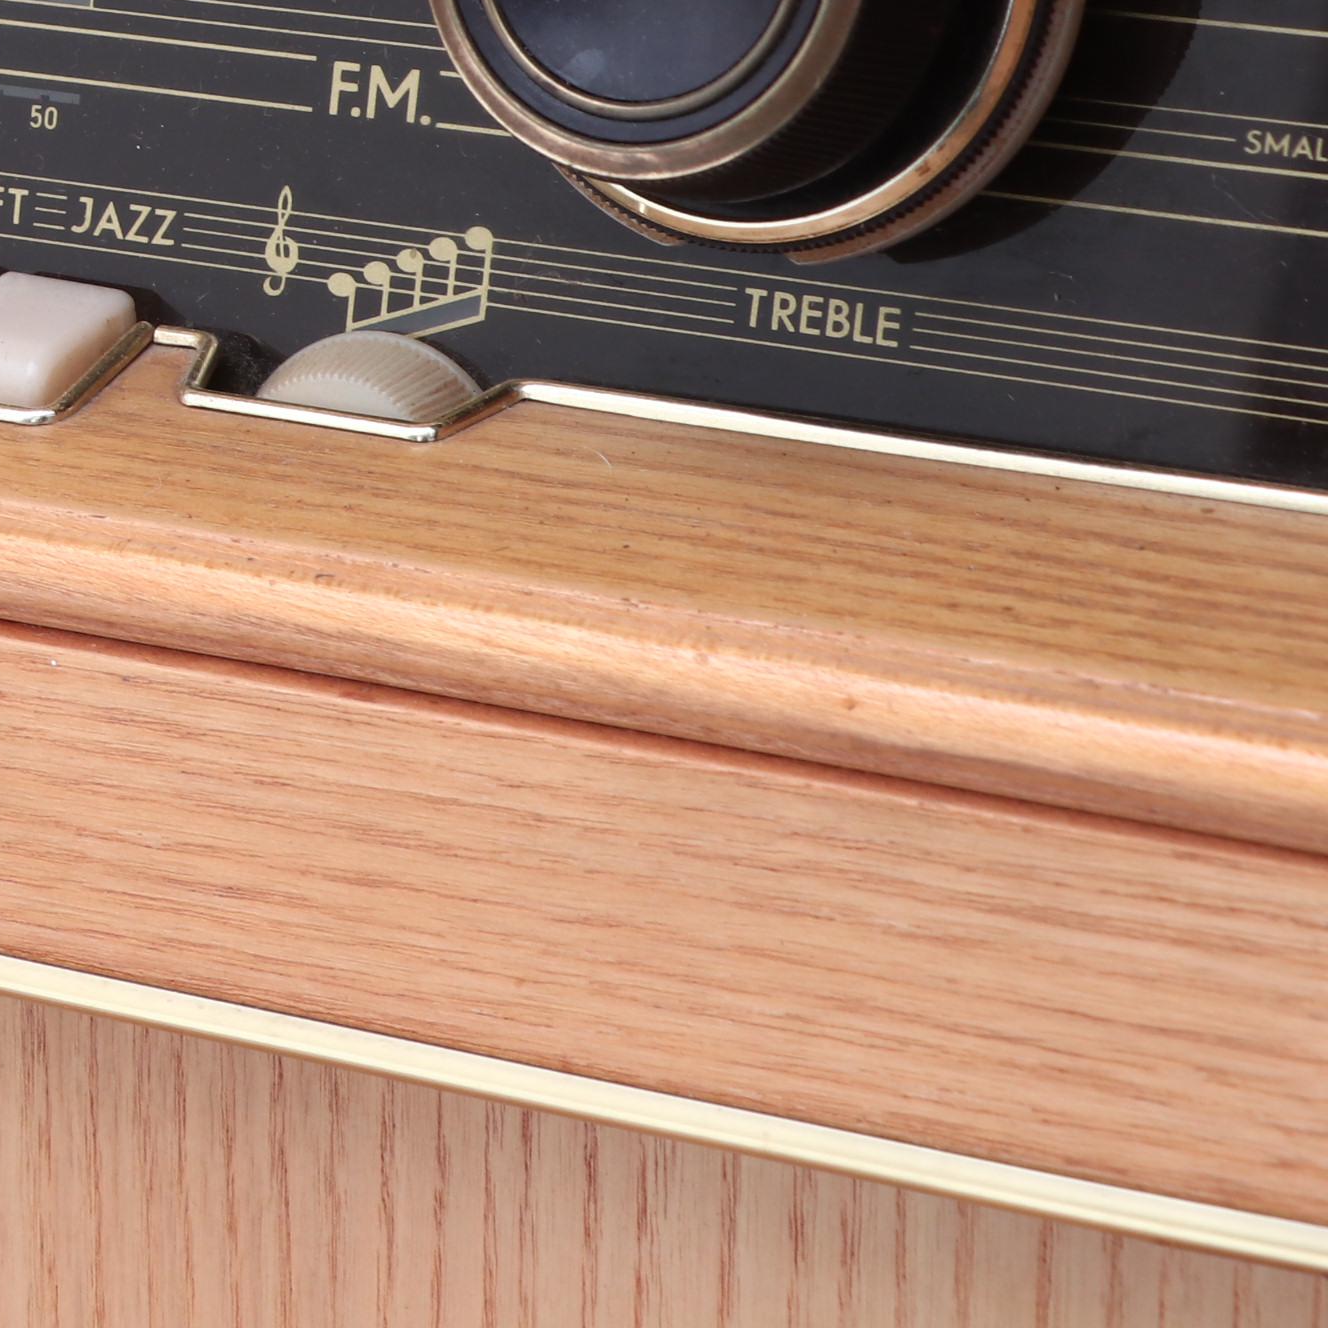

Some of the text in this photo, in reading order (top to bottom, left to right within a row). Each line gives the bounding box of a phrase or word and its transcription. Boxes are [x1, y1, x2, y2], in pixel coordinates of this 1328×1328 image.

[30, 105, 58, 131] 50
[329, 62, 431, 126] F.M.
[69, 197, 176, 245] JAZZ
[744, 287, 901, 348] TREBLE
